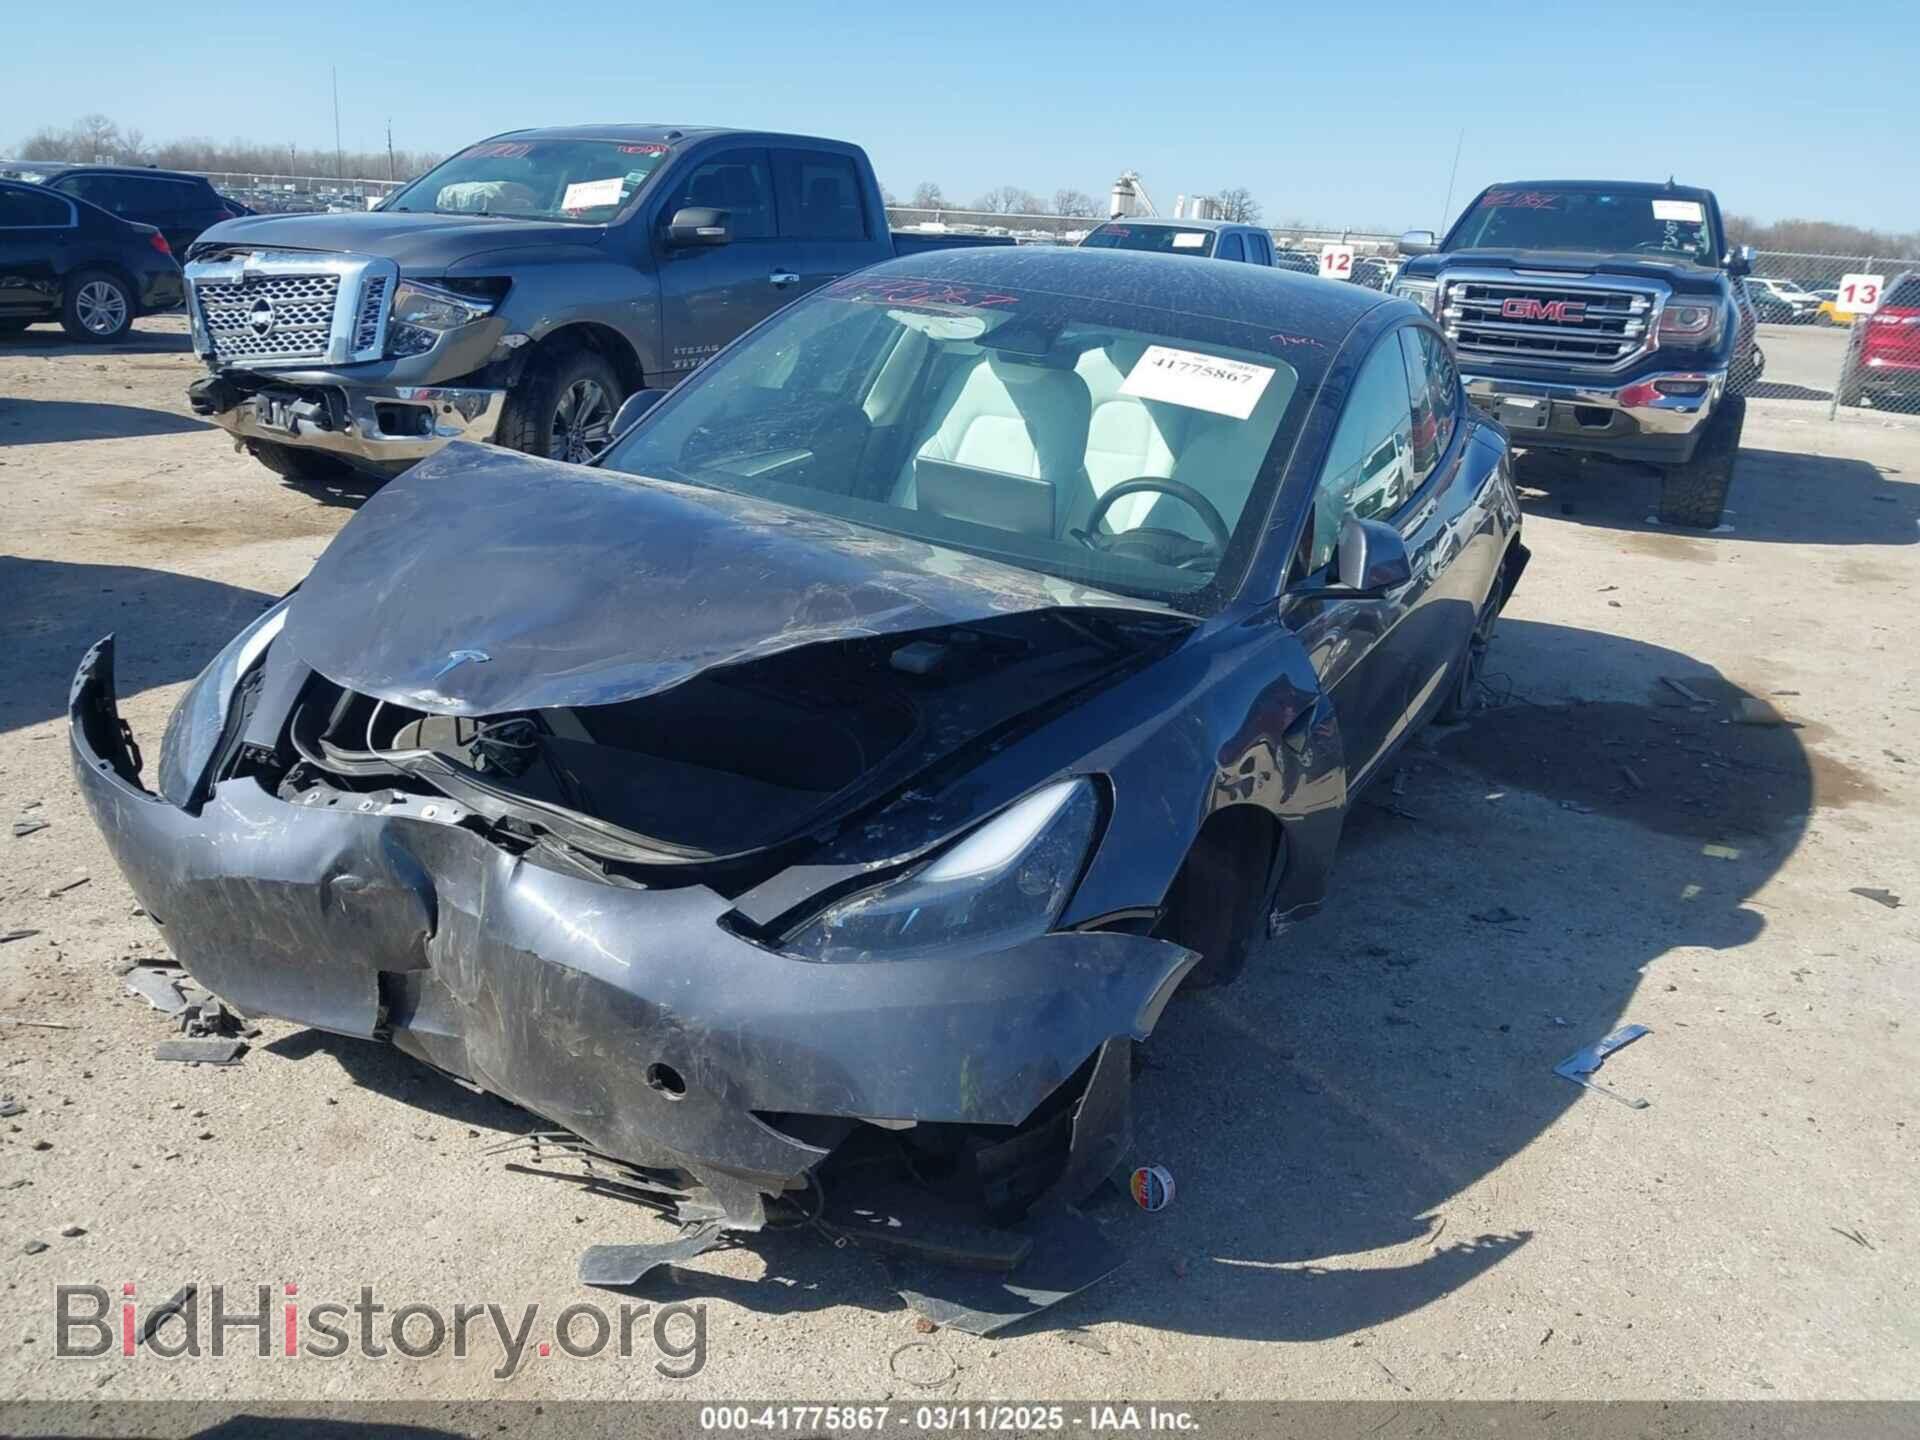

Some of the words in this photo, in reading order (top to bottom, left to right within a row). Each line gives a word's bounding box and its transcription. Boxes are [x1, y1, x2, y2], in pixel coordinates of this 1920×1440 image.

[1323, 253, 1351, 271] 12
[1843, 283, 1877, 305] 13
[1502, 297, 1586, 322] GMC
[1151, 357, 1254, 384] 41775867
